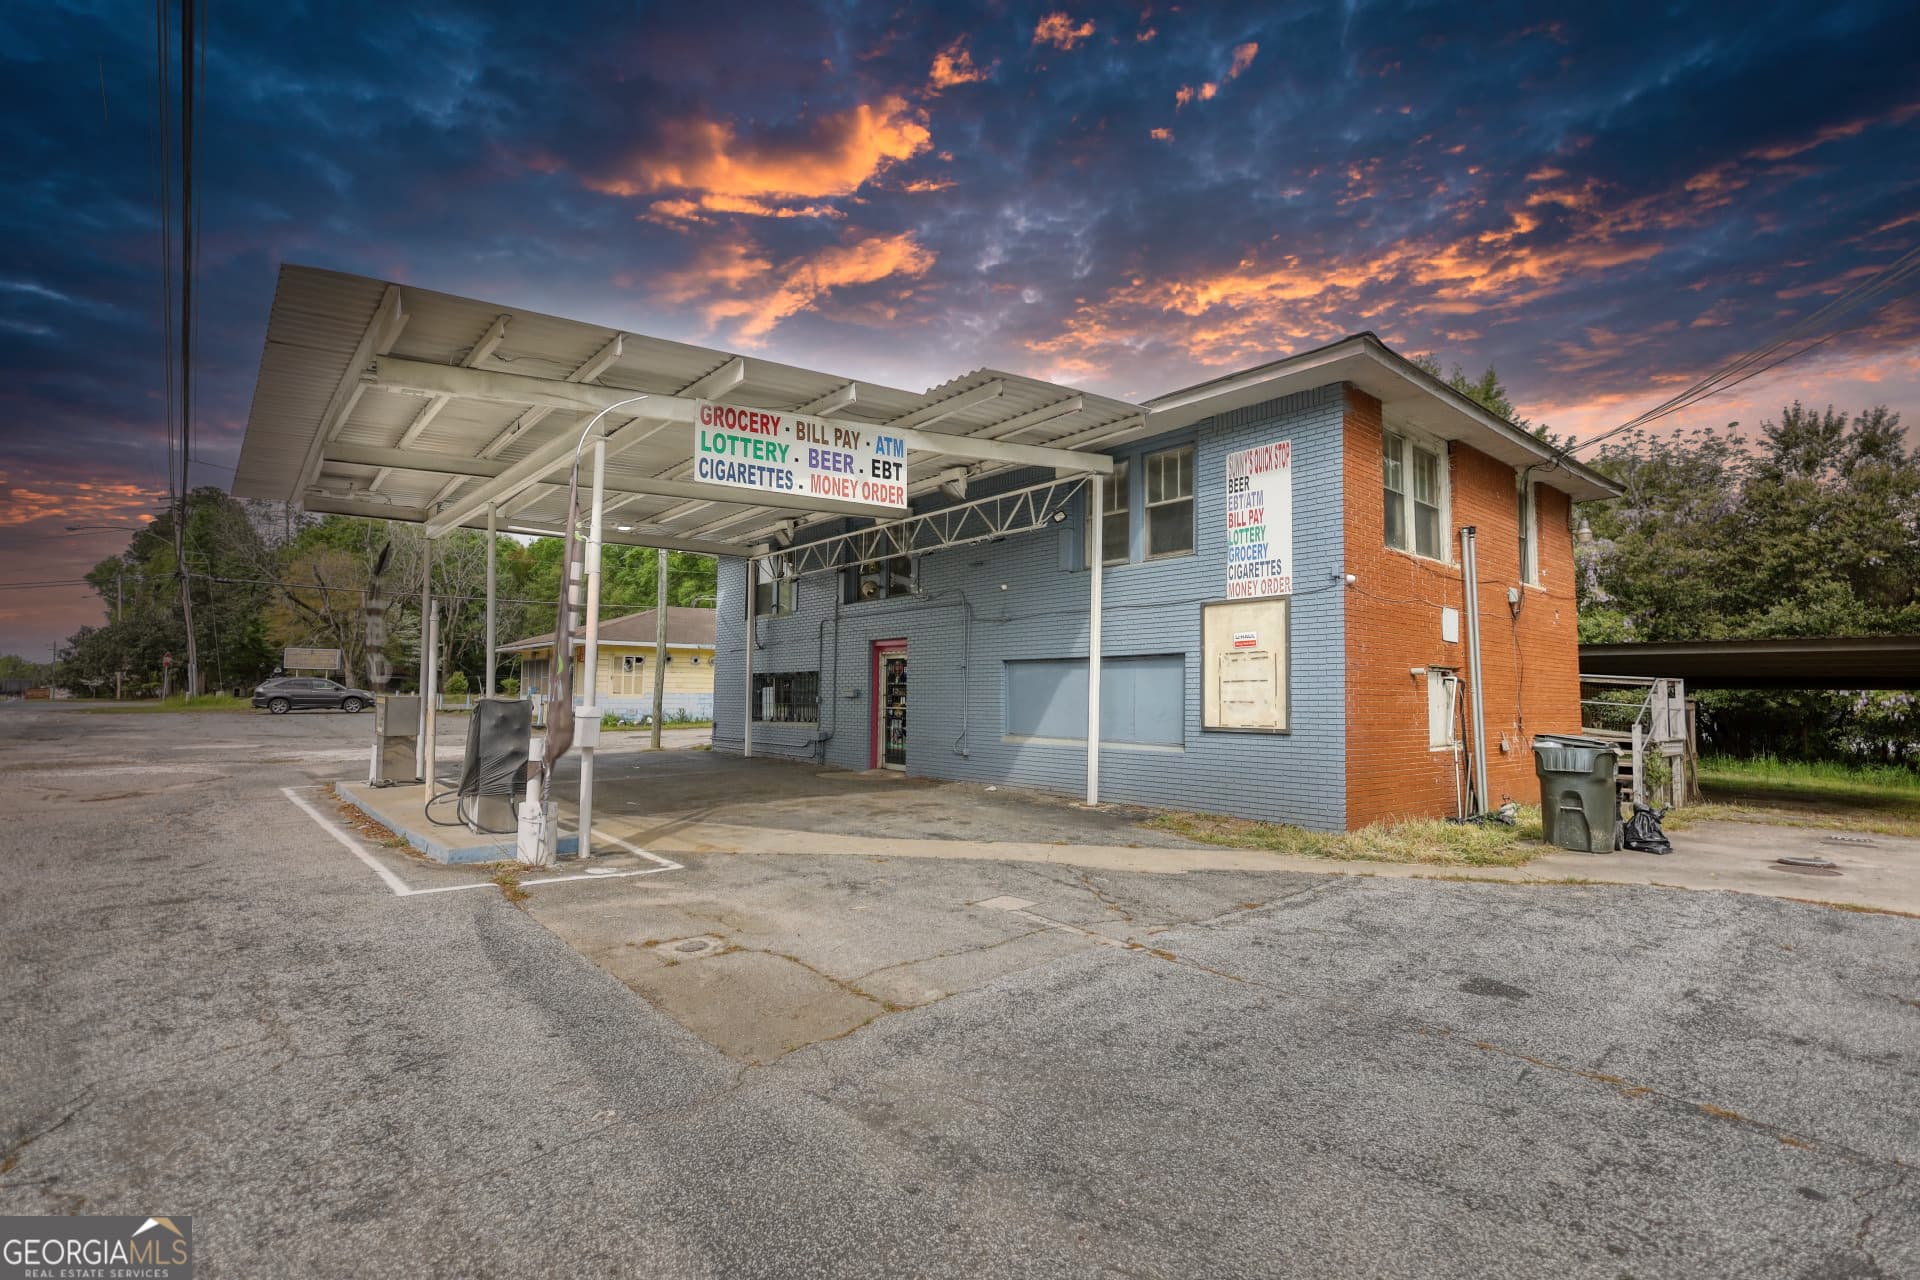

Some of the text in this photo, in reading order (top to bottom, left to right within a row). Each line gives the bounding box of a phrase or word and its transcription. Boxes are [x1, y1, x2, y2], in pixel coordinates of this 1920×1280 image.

[700, 405, 904, 458] GROCERY BILL PAY ATM
[701, 430, 902, 481] LOTTERY BEER EBT
[1254, 445, 1273, 474] QUICK
[1274, 441, 1290, 470] STOP
[699, 457, 904, 505] CIGARETTES MONEY ORDER
[1228, 476, 1250, 494] BEER
[1228, 490, 1264, 511] EBT/ATM
[1228, 508, 1264, 528] BILL PAY
[1228, 525, 1266, 546] LOTTERY
[1228, 543, 1269, 564] GROCERY
[1228, 559, 1282, 580] CIGARETTES
[1228, 576, 1291, 598] MONEY ORDER
